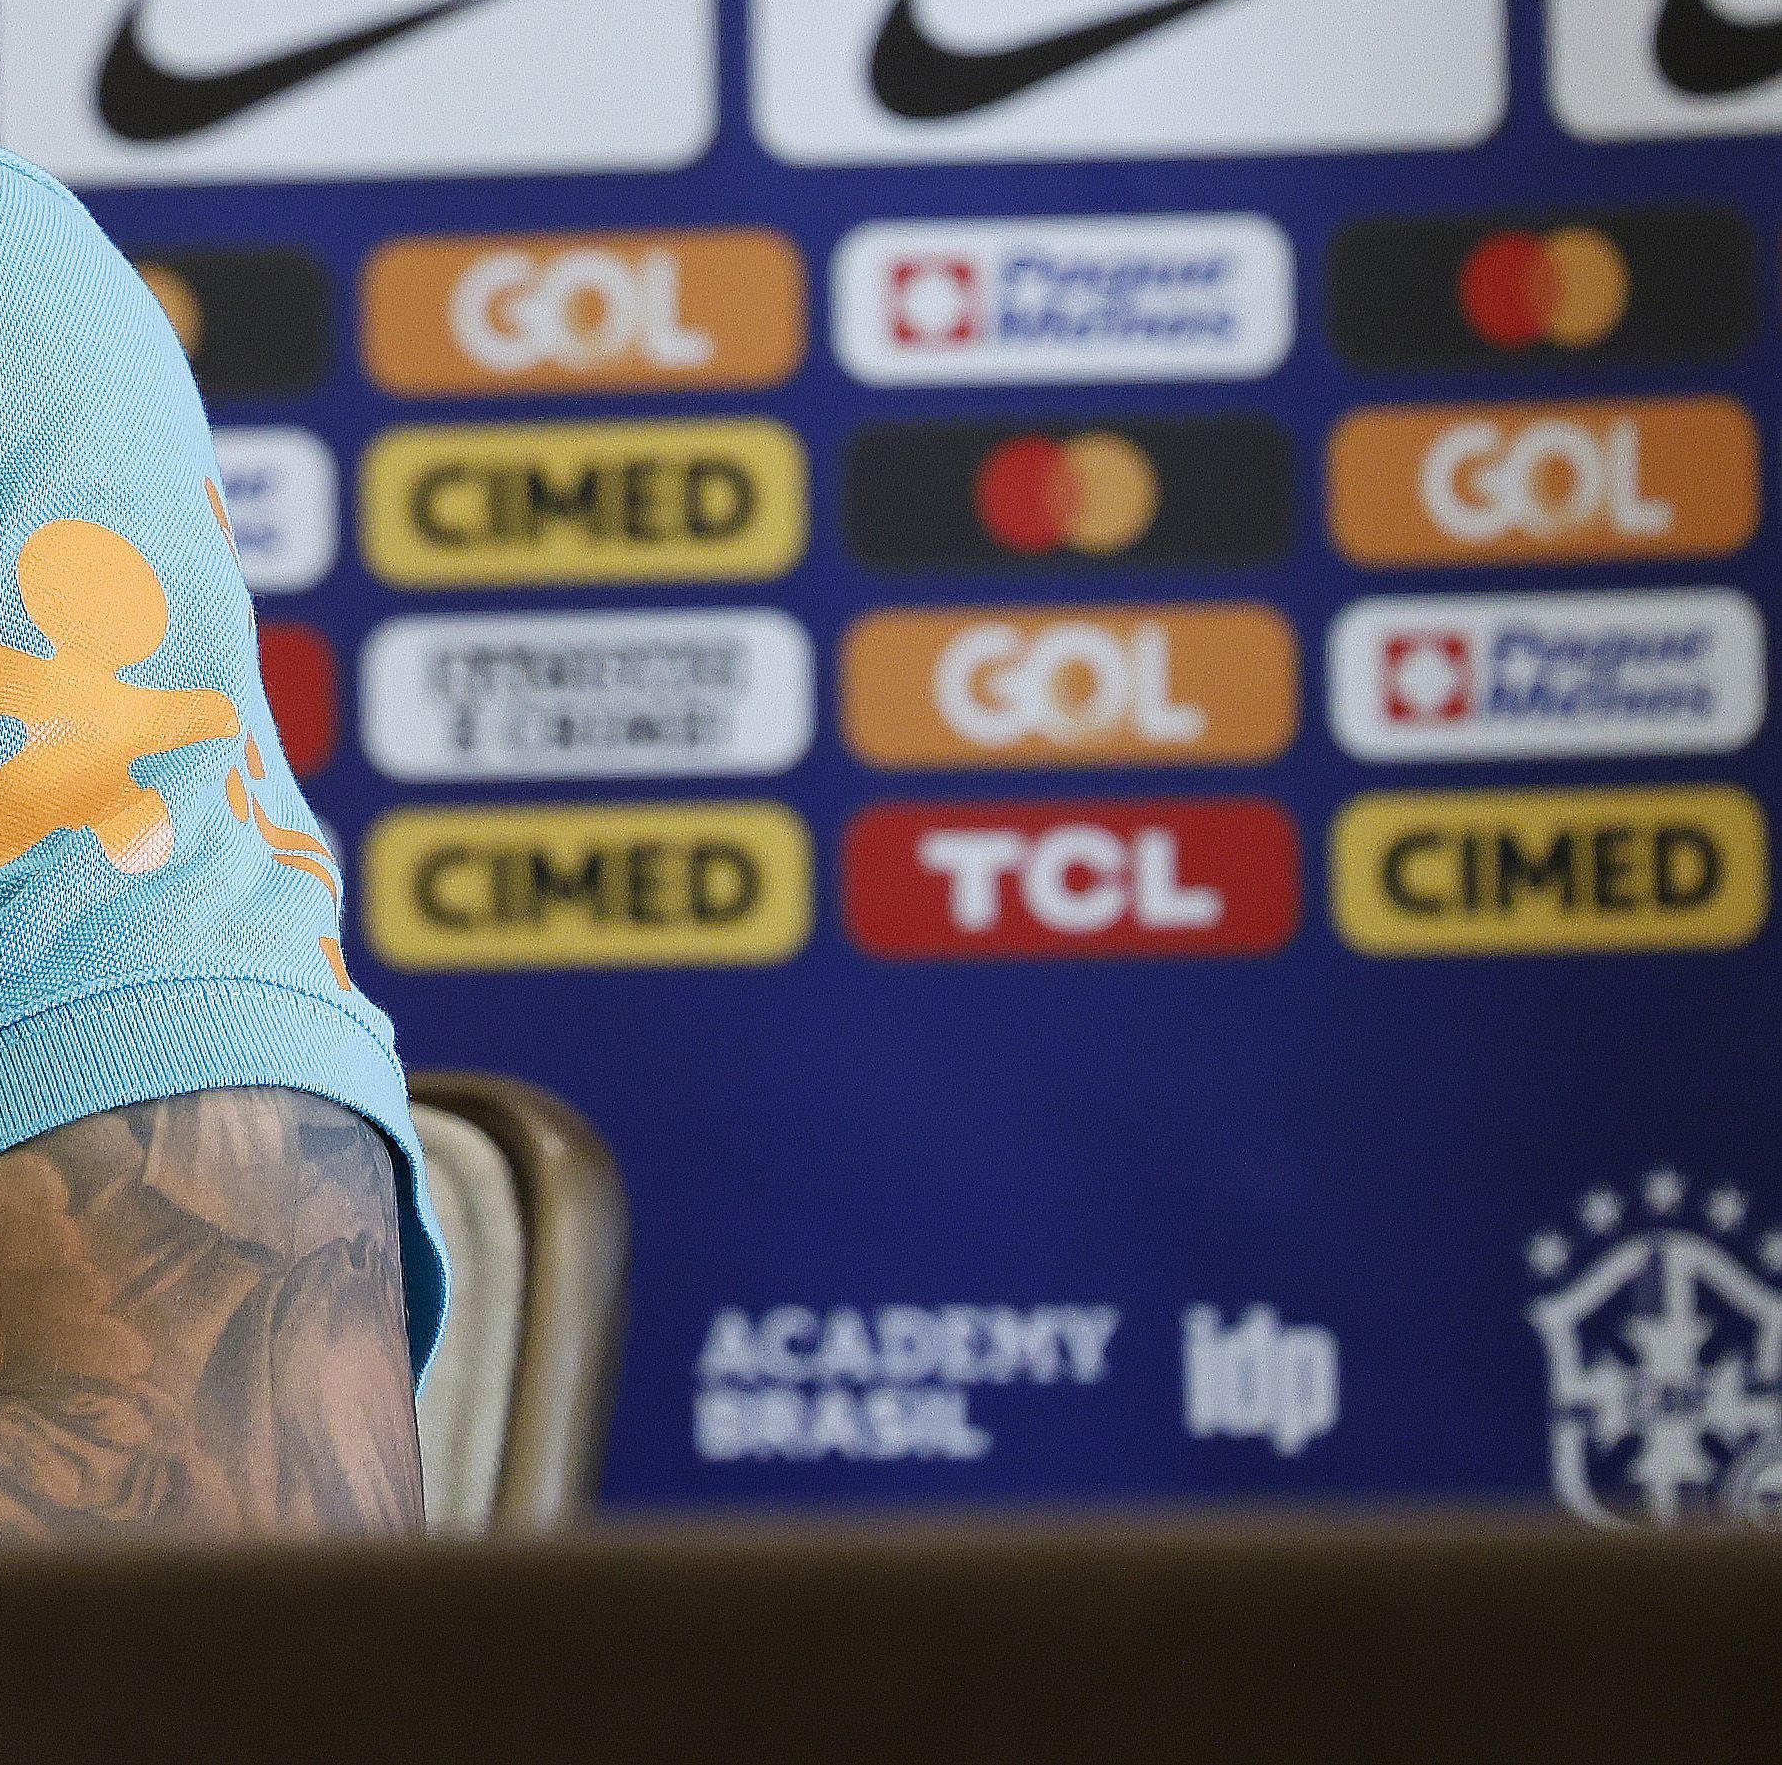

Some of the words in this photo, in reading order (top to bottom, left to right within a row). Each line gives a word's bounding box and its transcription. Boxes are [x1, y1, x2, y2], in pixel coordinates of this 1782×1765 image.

[451, 249, 712, 371] GOL
[409, 456, 761, 549] CIMED
[1418, 420, 1670, 542] GOL
[934, 623, 1203, 743] GOL
[413, 839, 766, 932] CIMED
[919, 825, 1220, 932] TCL
[1377, 824, 1722, 918] CIMED
[698, 1302, 1119, 1384] ACADEMY
[696, 1386, 994, 1460] BRASIL
